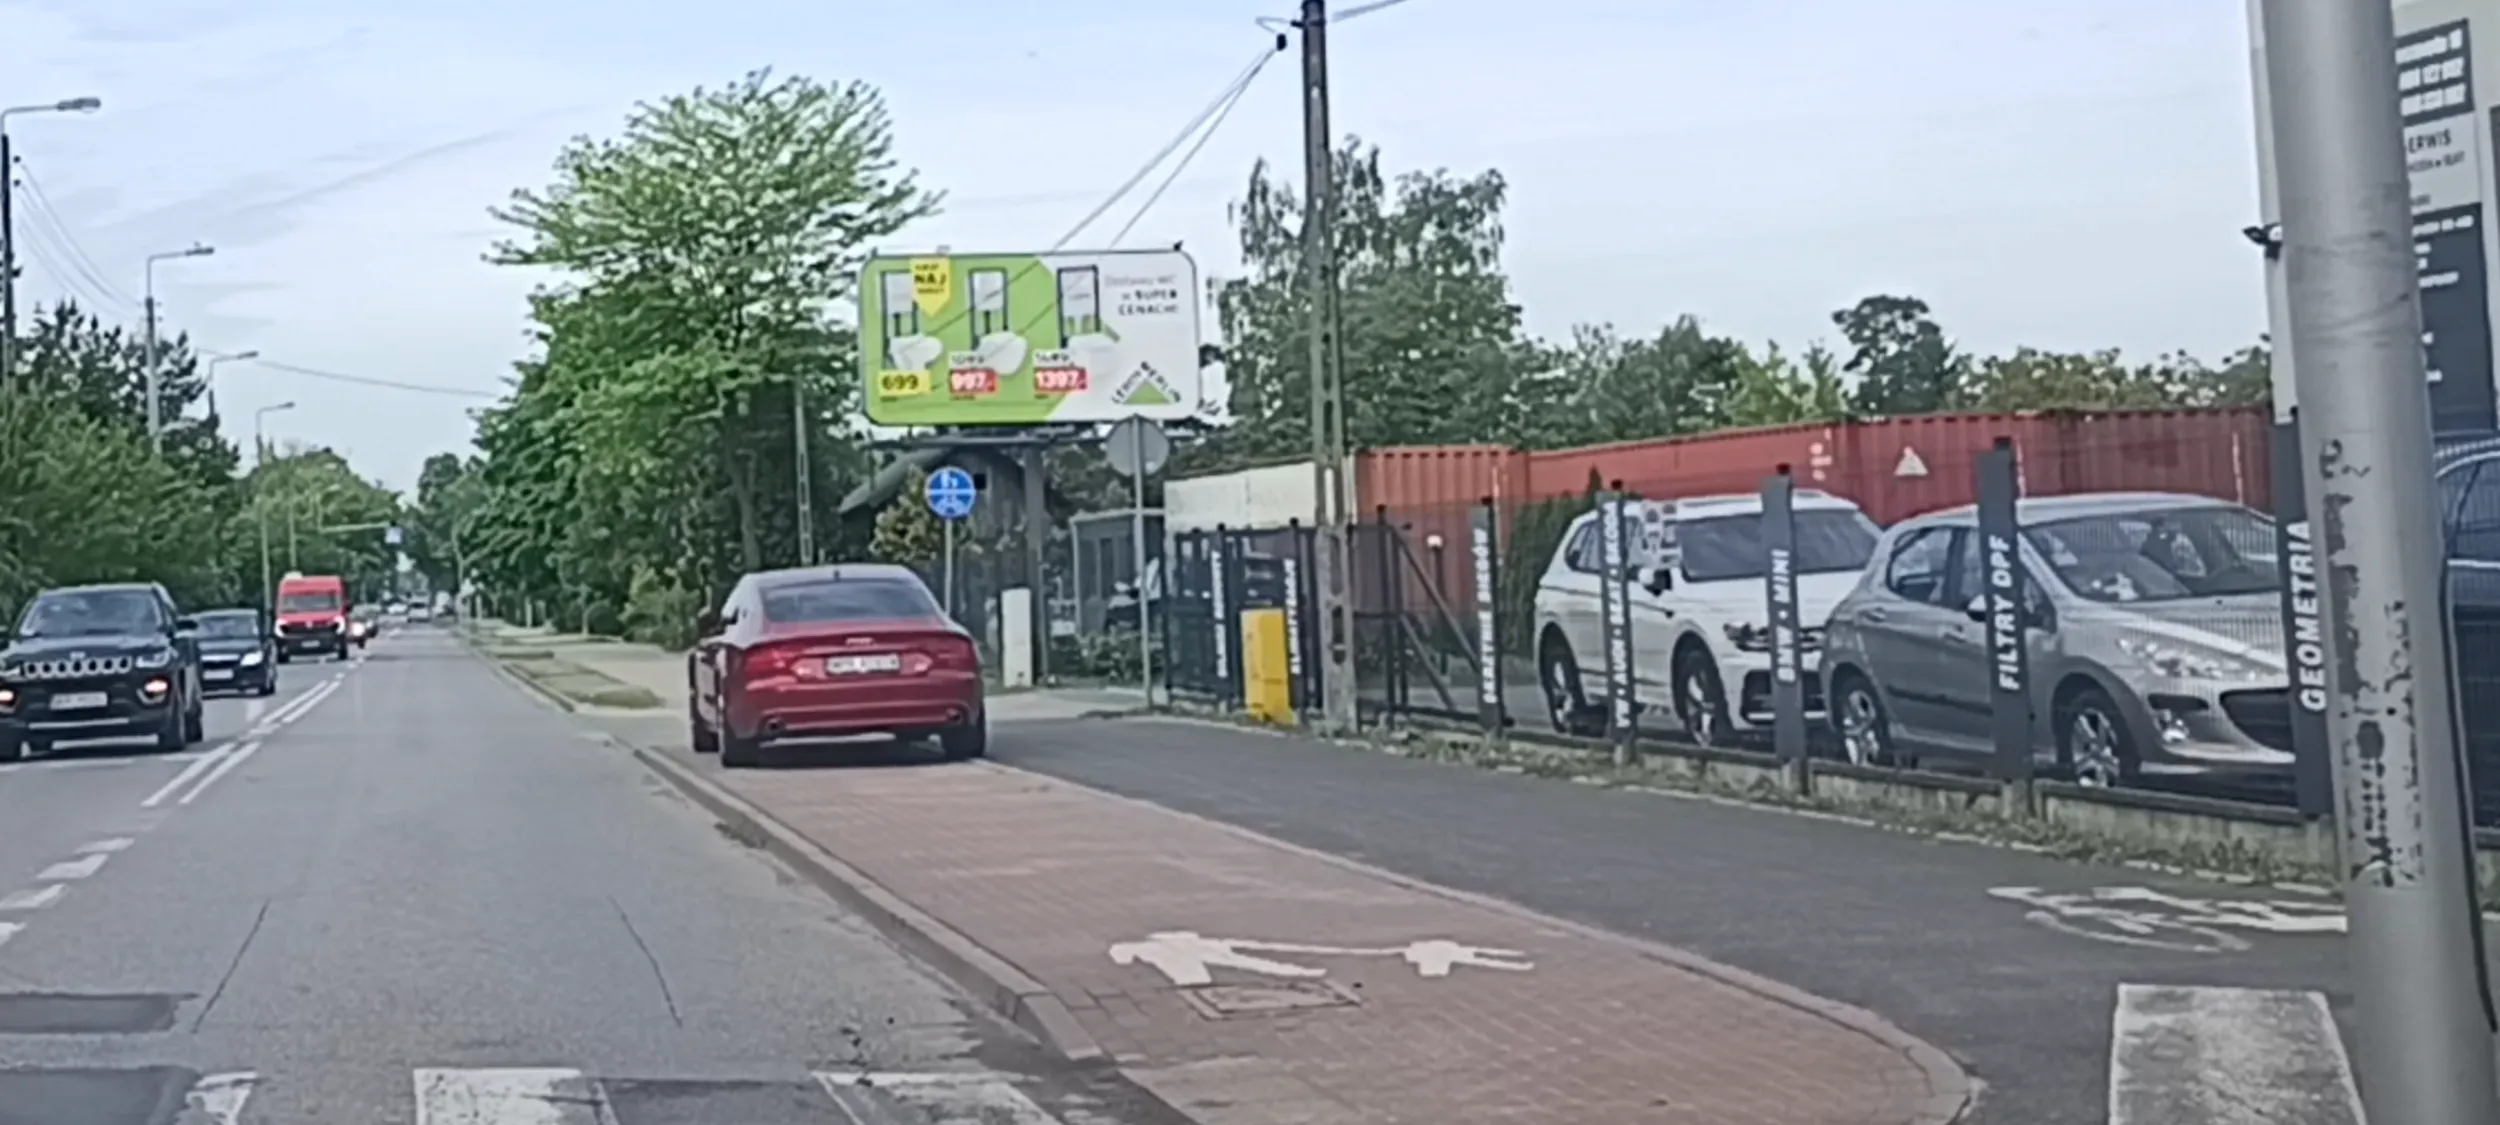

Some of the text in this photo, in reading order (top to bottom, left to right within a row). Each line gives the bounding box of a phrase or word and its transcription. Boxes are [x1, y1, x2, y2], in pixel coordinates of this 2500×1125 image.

[881, 374, 919, 390] 699
[1771, 550, 1796, 682] BMW MINI
[1988, 534, 2021, 691] FILTRY DPF
[2286, 521, 2327, 712] GEOMETRIA
